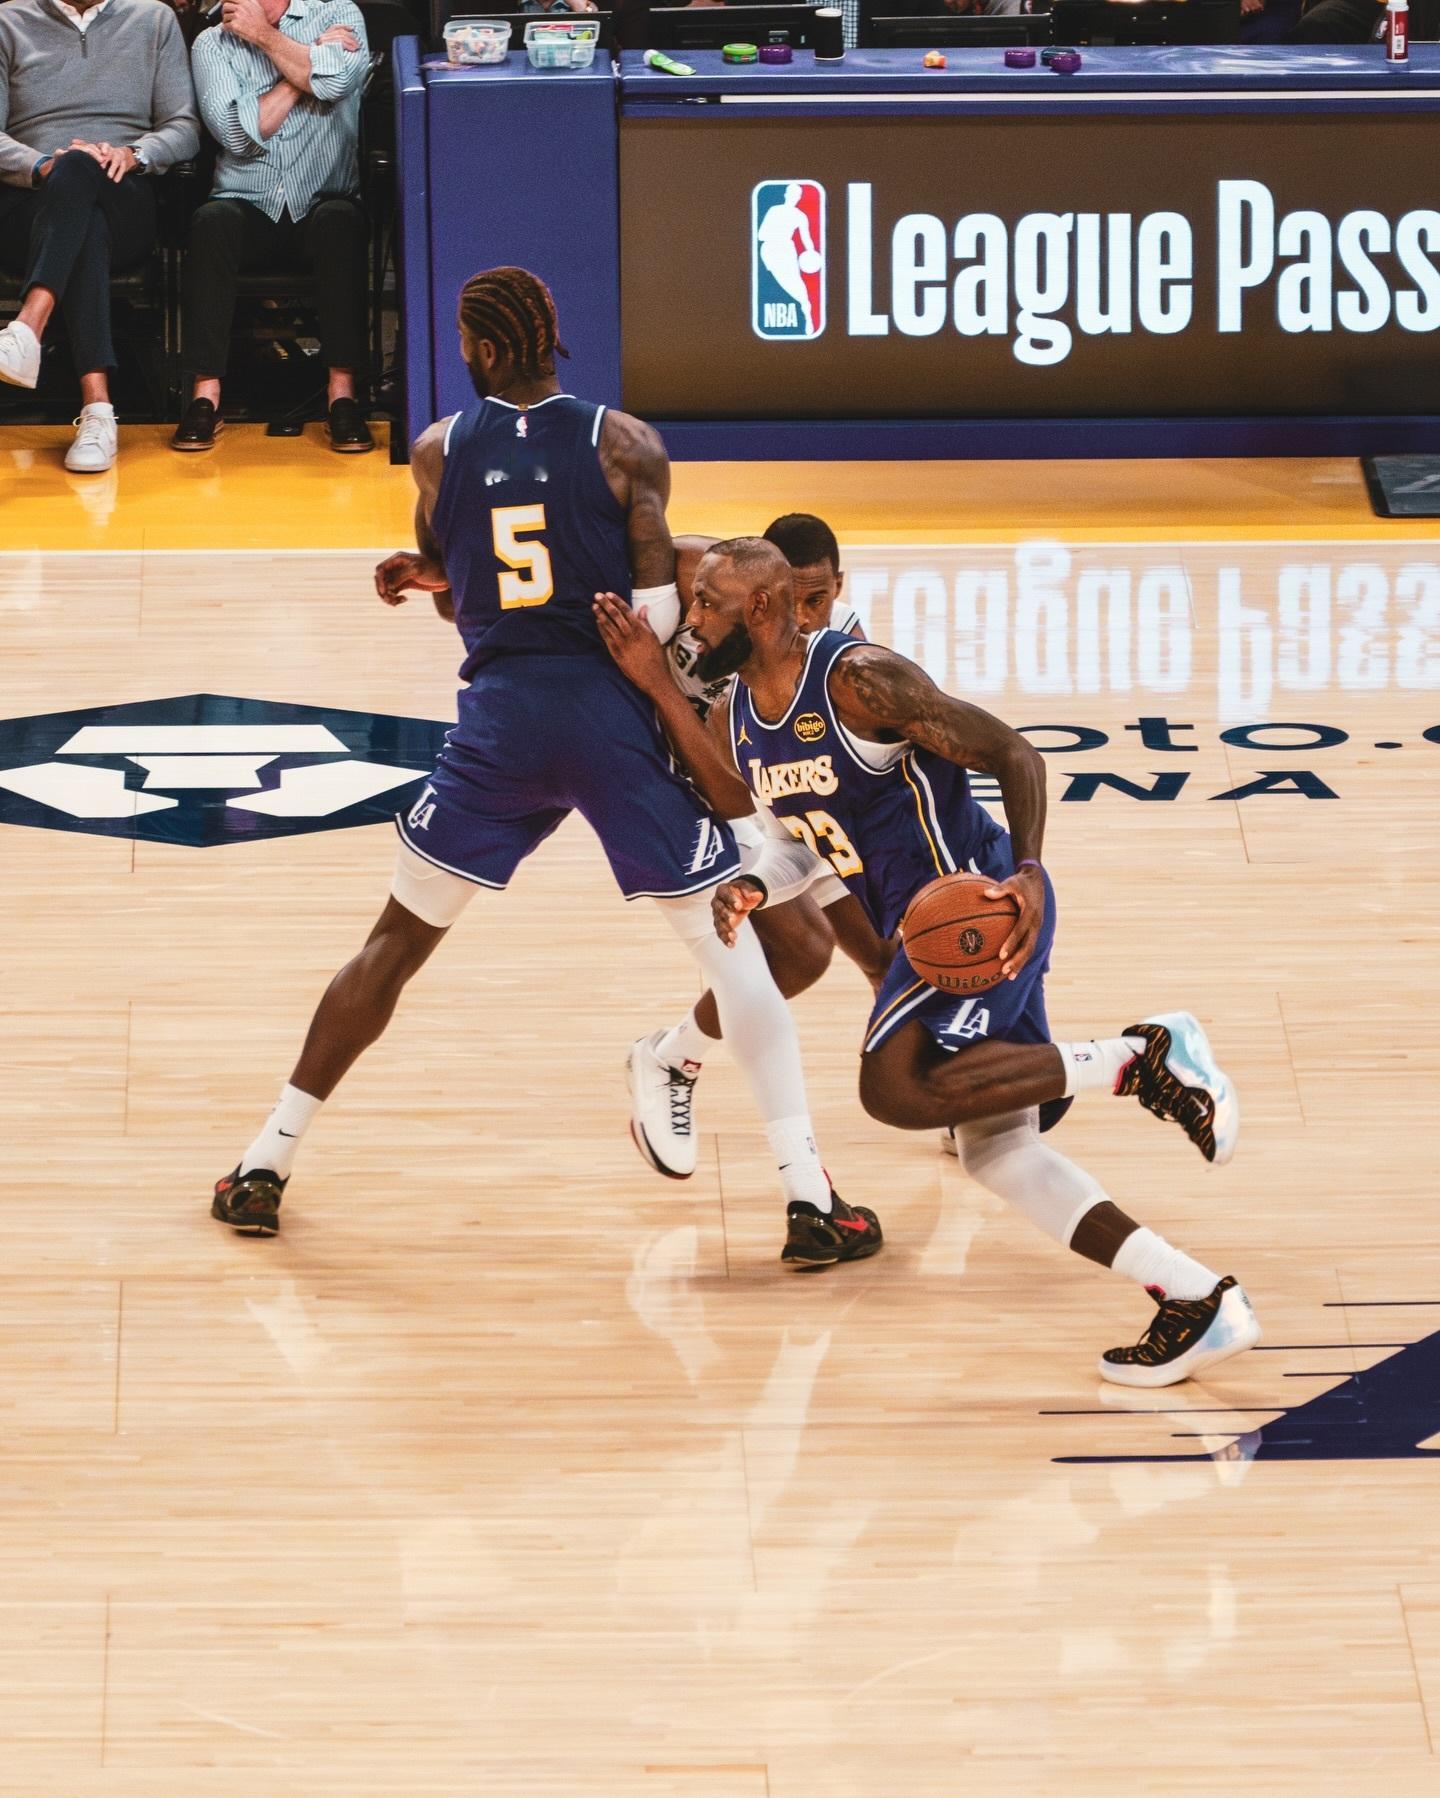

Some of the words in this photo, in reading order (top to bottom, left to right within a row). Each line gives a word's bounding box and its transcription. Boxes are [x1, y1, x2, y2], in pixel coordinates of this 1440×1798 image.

[848, 182, 1193, 365] League
[1218, 179, 1440, 333] Pass
[764, 302, 798, 328] NBA
[491, 503, 554, 610] 5
[796, 720, 824, 733] bibigo
[748, 755, 839, 807] LAKERS
[684, 817, 725, 875] LA
[936, 972, 1002, 989] Wilso
[939, 997, 988, 1039] LA
